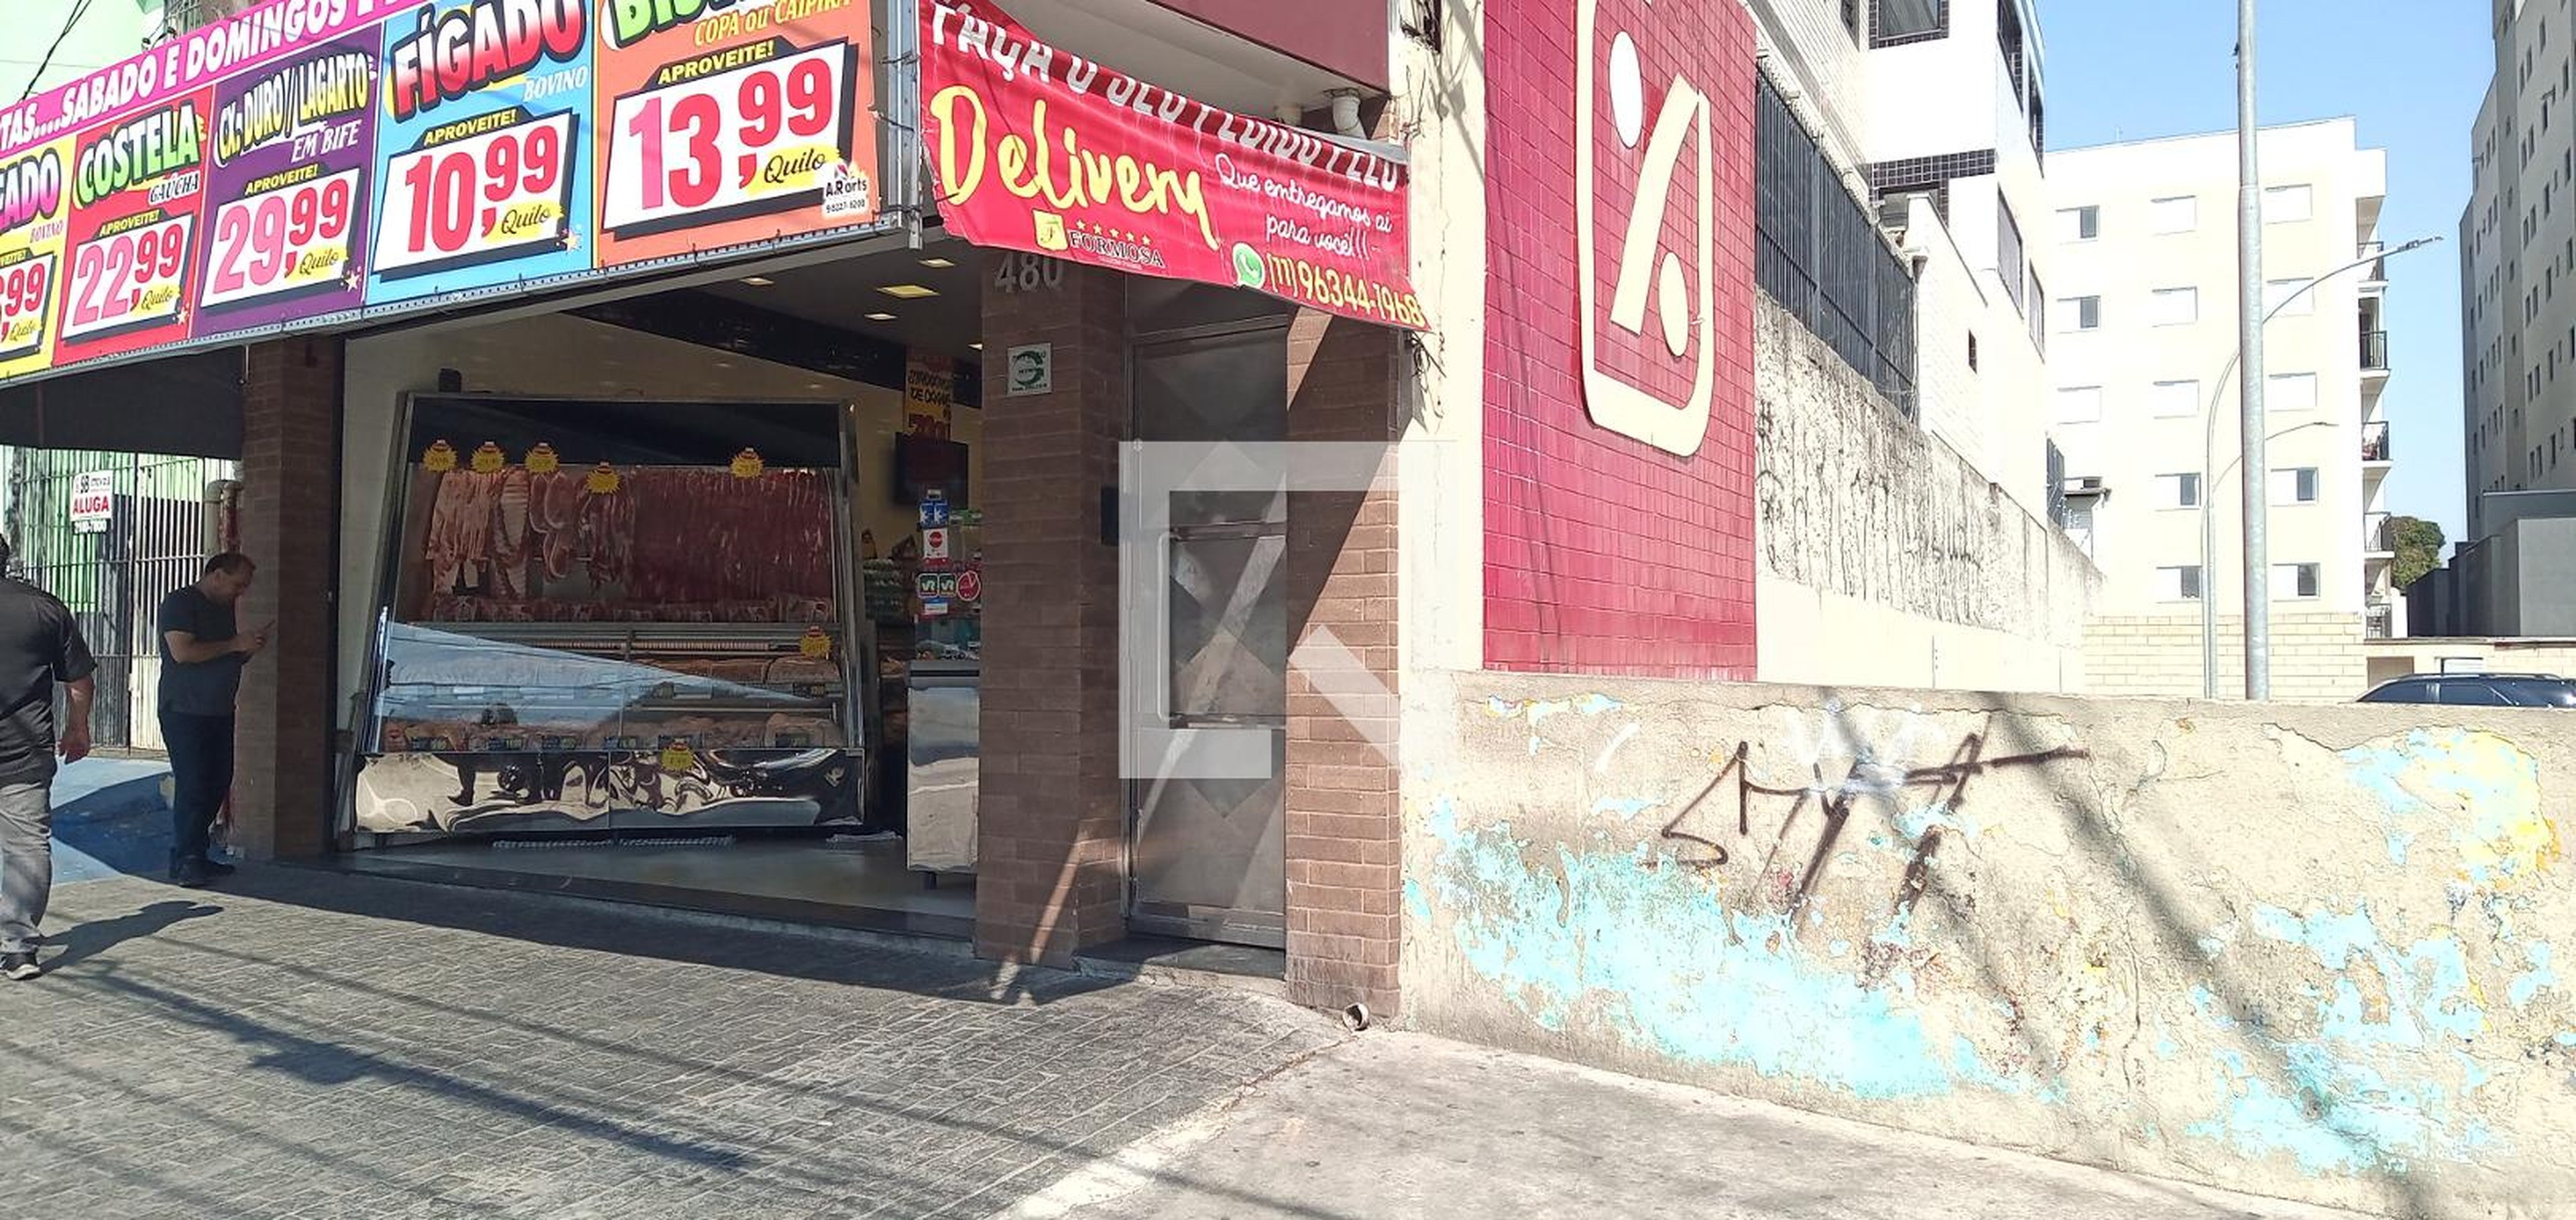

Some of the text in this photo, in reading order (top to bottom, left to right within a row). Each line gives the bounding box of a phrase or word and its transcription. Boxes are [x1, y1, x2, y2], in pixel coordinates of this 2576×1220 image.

[694, 11, 739, 46] COPA
[163, 45, 178, 89] E
[394, 0, 581, 115] FÍGADO
[657, 42, 775, 85] APROVEITE!
[299, 52, 368, 121] LAGARTO
[522, 65, 588, 102] BOVINO
[291, 119, 362, 162] EM BIFE
[423, 109, 517, 146] APROVEITE!
[629, 58, 832, 211] 13,99
[76, 103, 201, 206] COSTELA
[764, 148, 826, 183] Quilo
[930, 85, 1222, 252] Delivery
[245, 163, 319, 195] APROVEITE!
[405, 125, 559, 252] 10,99
[1215, 153, 1262, 192] Que
[1265, 177, 1372, 227] entregamos
[101, 209, 160, 237] APROVEITE!
[213, 178, 349, 294] 29,99
[500, 204, 551, 235] Quilo
[1266, 213, 1310, 243] para
[299, 248, 339, 275] Quilo
[1067, 229, 1166, 268] FORMOSA
[72, 223, 183, 327] 22,99
[994, 252, 1065, 293] 480
[0, 263, 46, 343] ,99
[72, 496, 110, 515] ALUGA
